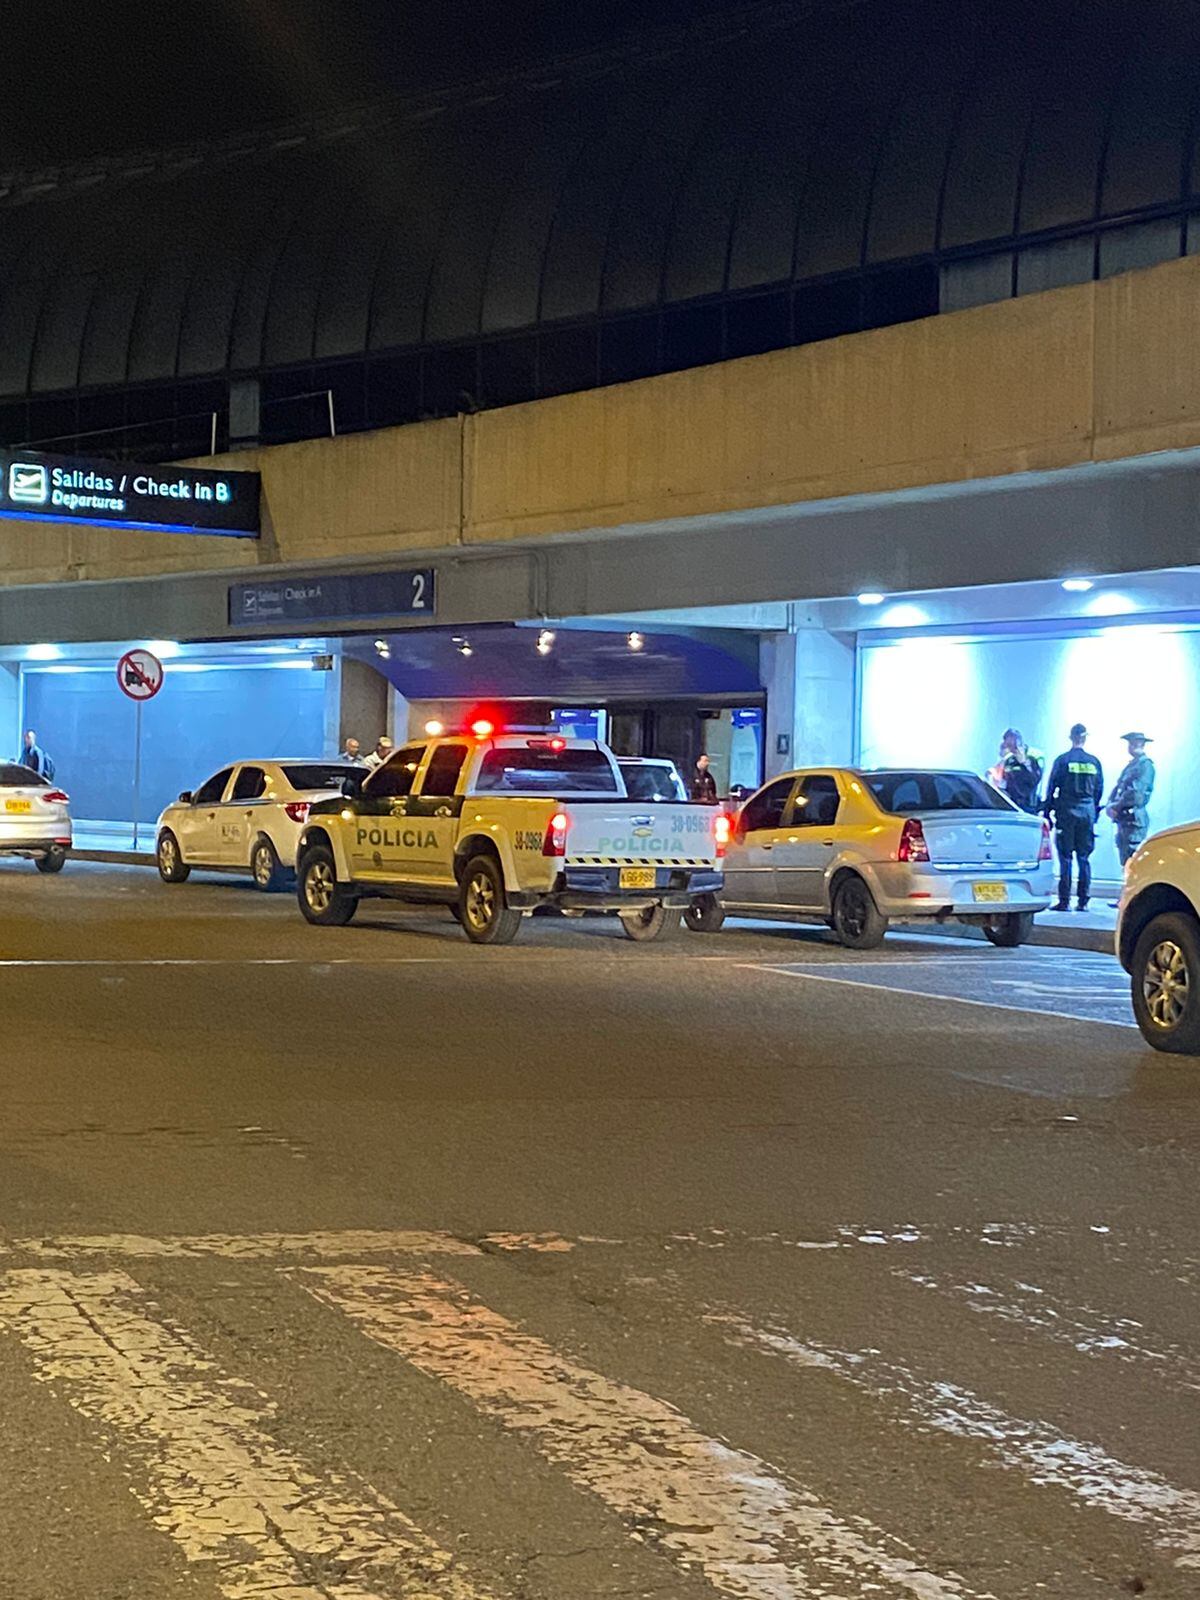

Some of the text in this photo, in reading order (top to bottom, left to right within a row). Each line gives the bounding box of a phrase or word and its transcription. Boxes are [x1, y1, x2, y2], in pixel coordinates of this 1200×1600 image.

[52, 468, 114, 491] Salidas
[133, 476, 190, 499] Check
[194, 482, 212, 500] in
[215, 482, 230, 501] B
[52, 489, 125, 511] Departures
[412, 574, 425, 608] 2
[356, 828, 439, 848] POLICIA
[598, 837, 685, 852] POLICIA
